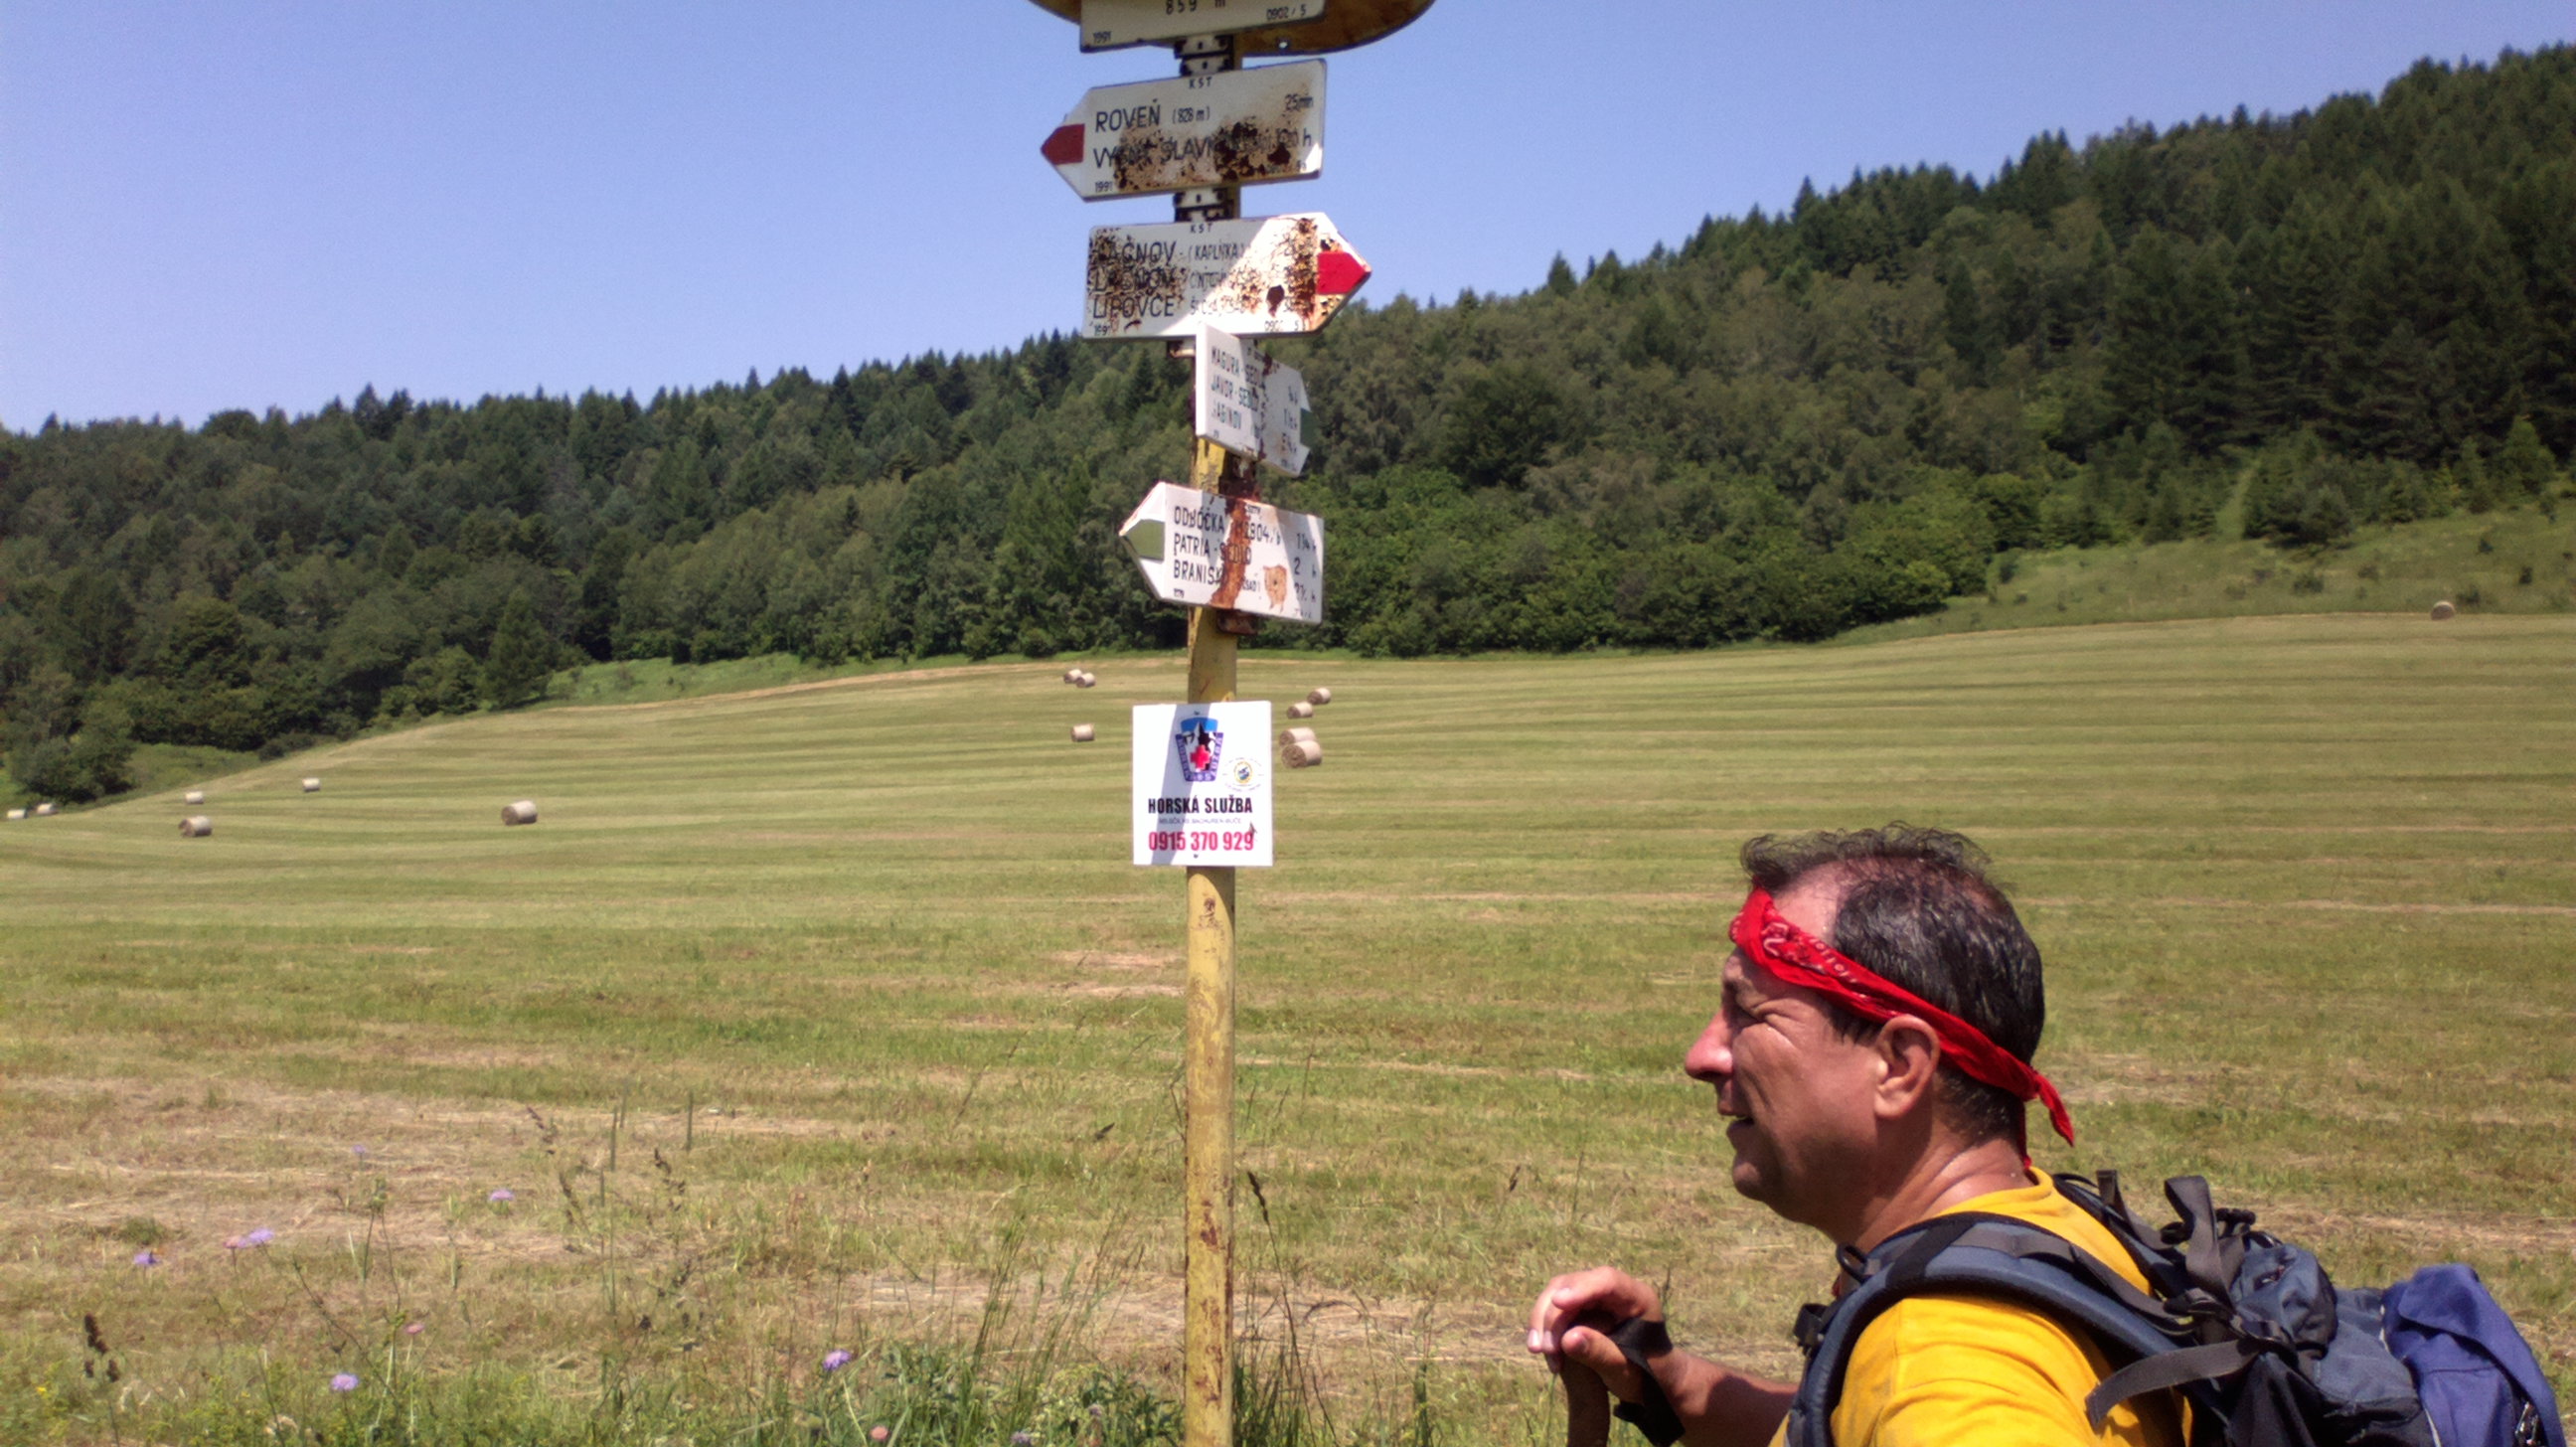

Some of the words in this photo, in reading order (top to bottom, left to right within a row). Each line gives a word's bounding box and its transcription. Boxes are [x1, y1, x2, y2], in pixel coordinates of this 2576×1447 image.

[1094, 97, 1162, 133] ROVEŇ
[1148, 795, 1200, 814] HORSKÁ
[1205, 794, 1253, 814] SLUŽBA
[1149, 832, 1186, 851] 0915
[1191, 832, 1218, 851] 370
[1222, 831, 1254, 851] 929
